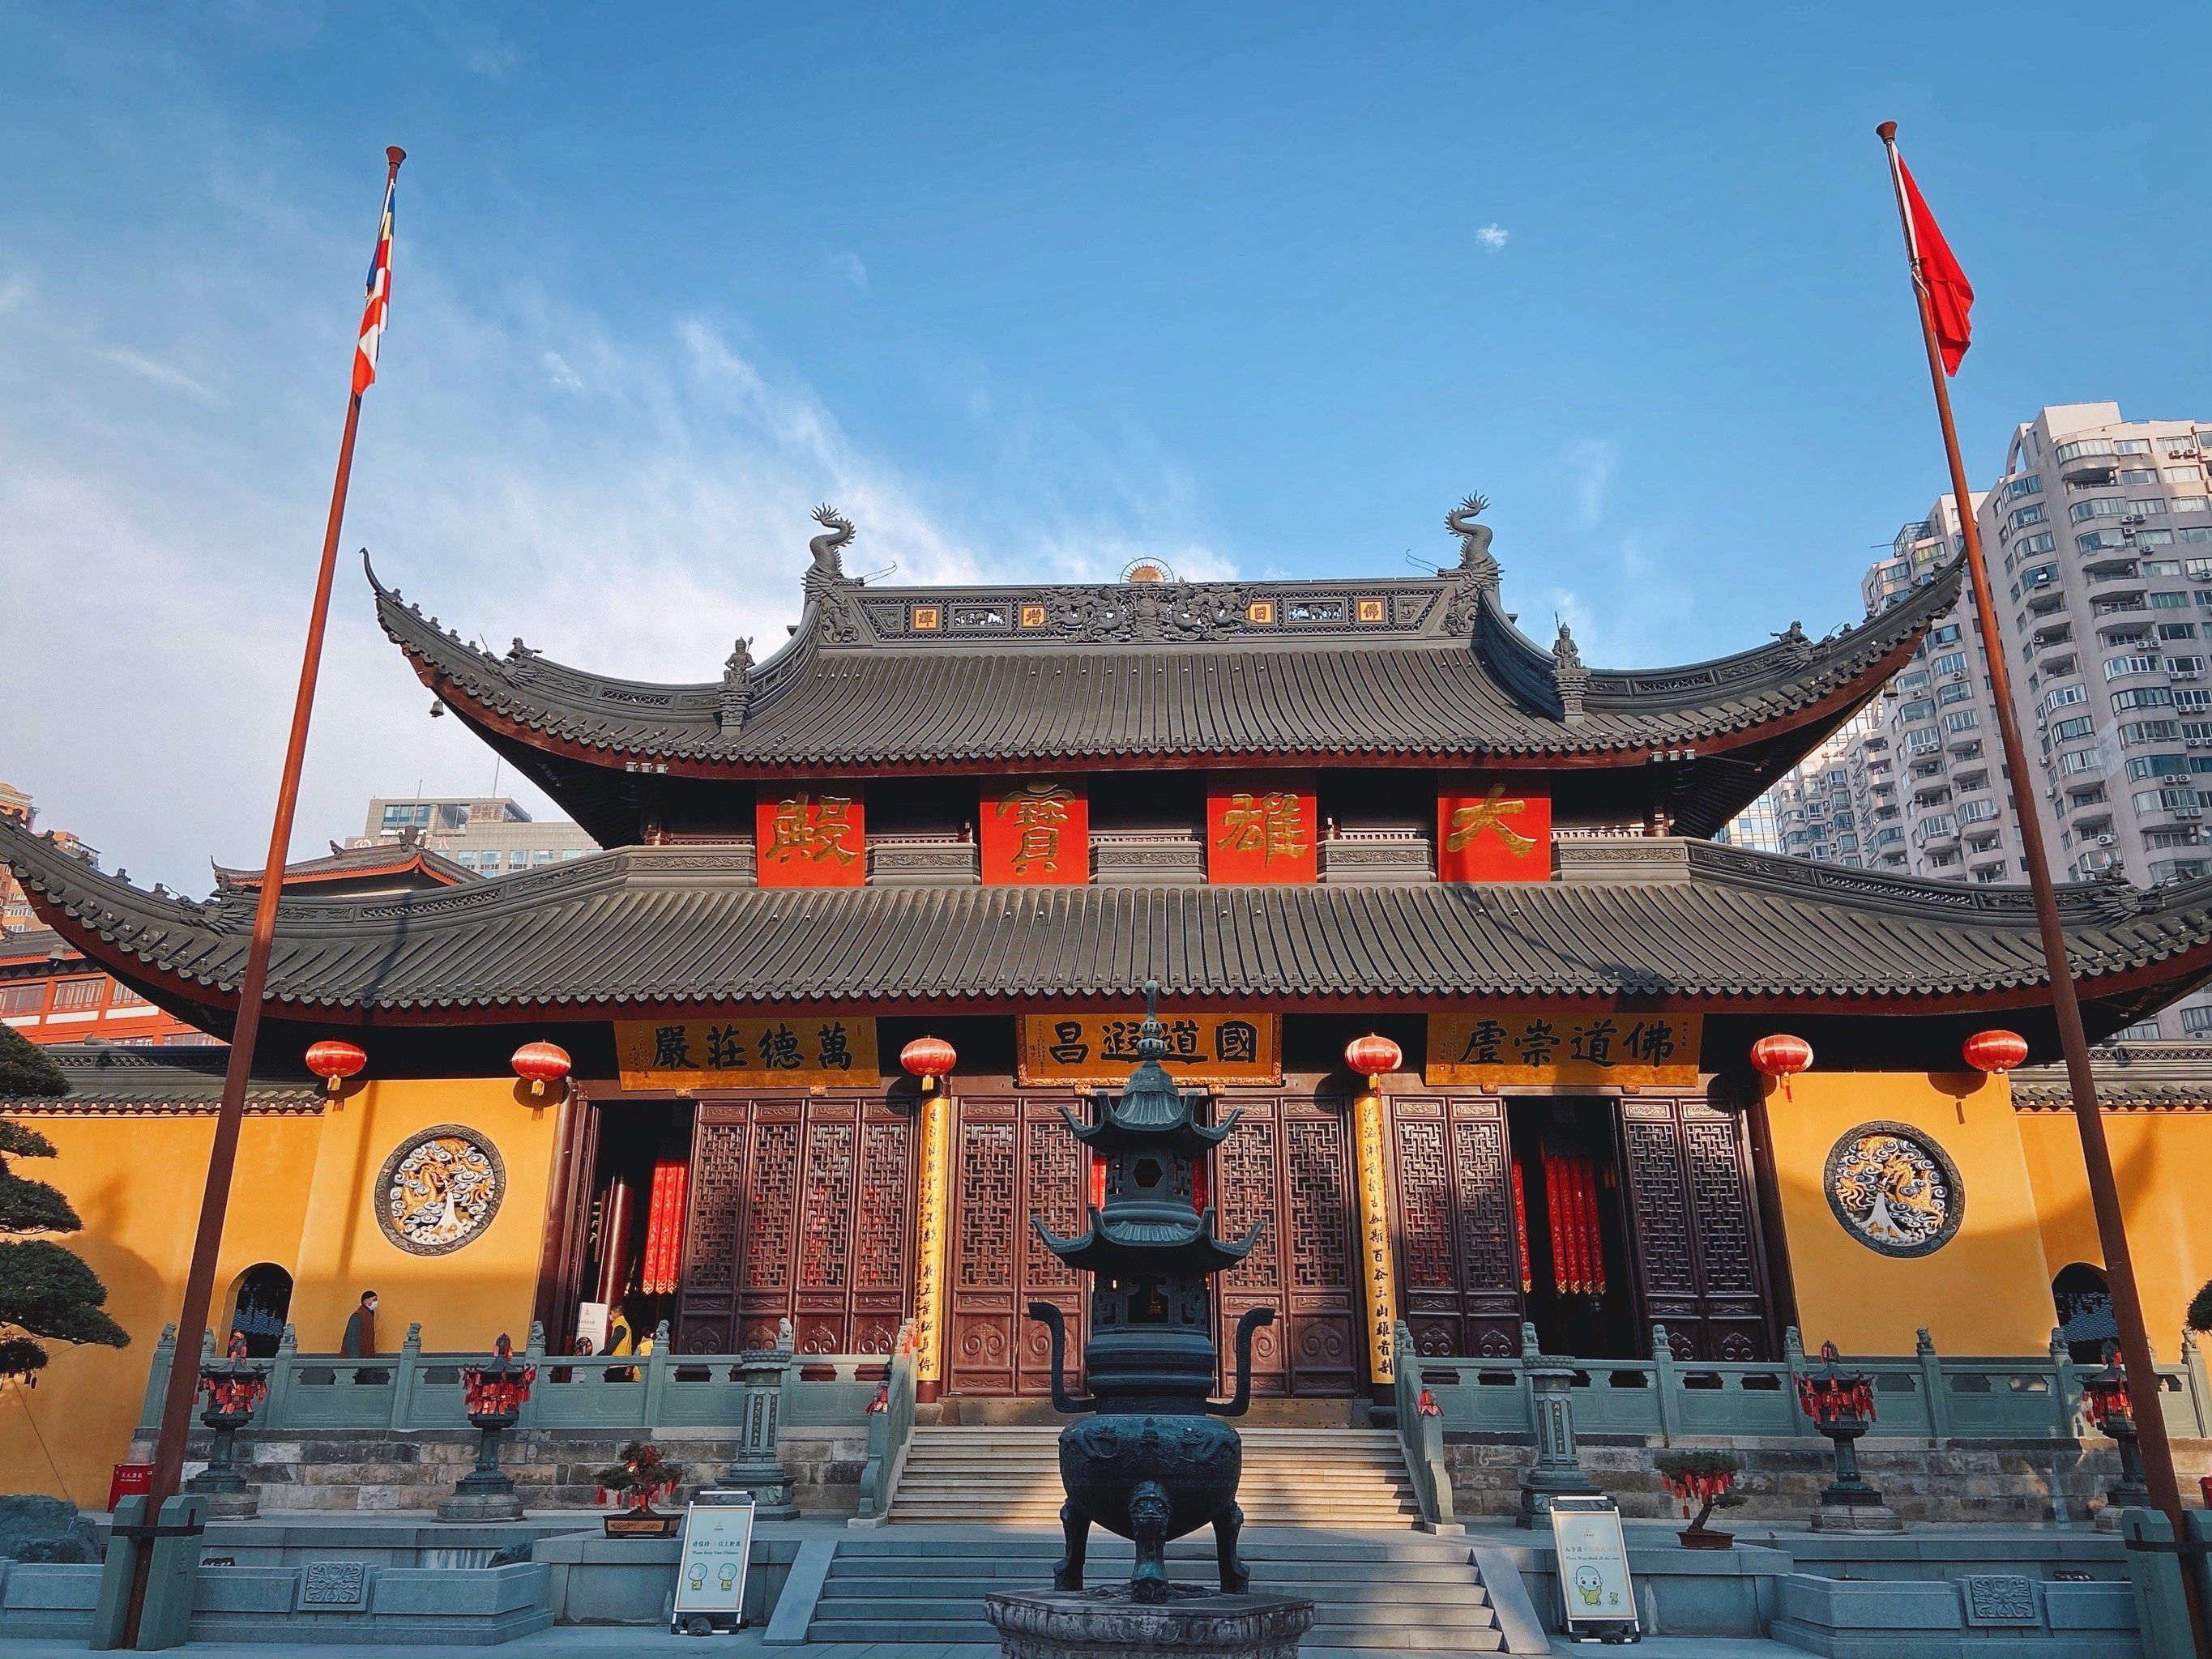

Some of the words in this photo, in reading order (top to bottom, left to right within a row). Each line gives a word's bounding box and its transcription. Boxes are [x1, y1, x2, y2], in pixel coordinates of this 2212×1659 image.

[765, 791, 859, 865] 殿
[995, 780, 1076, 876] 寶
[1215, 791, 1309, 868] 雄
[1446, 783, 1537, 859] 大
